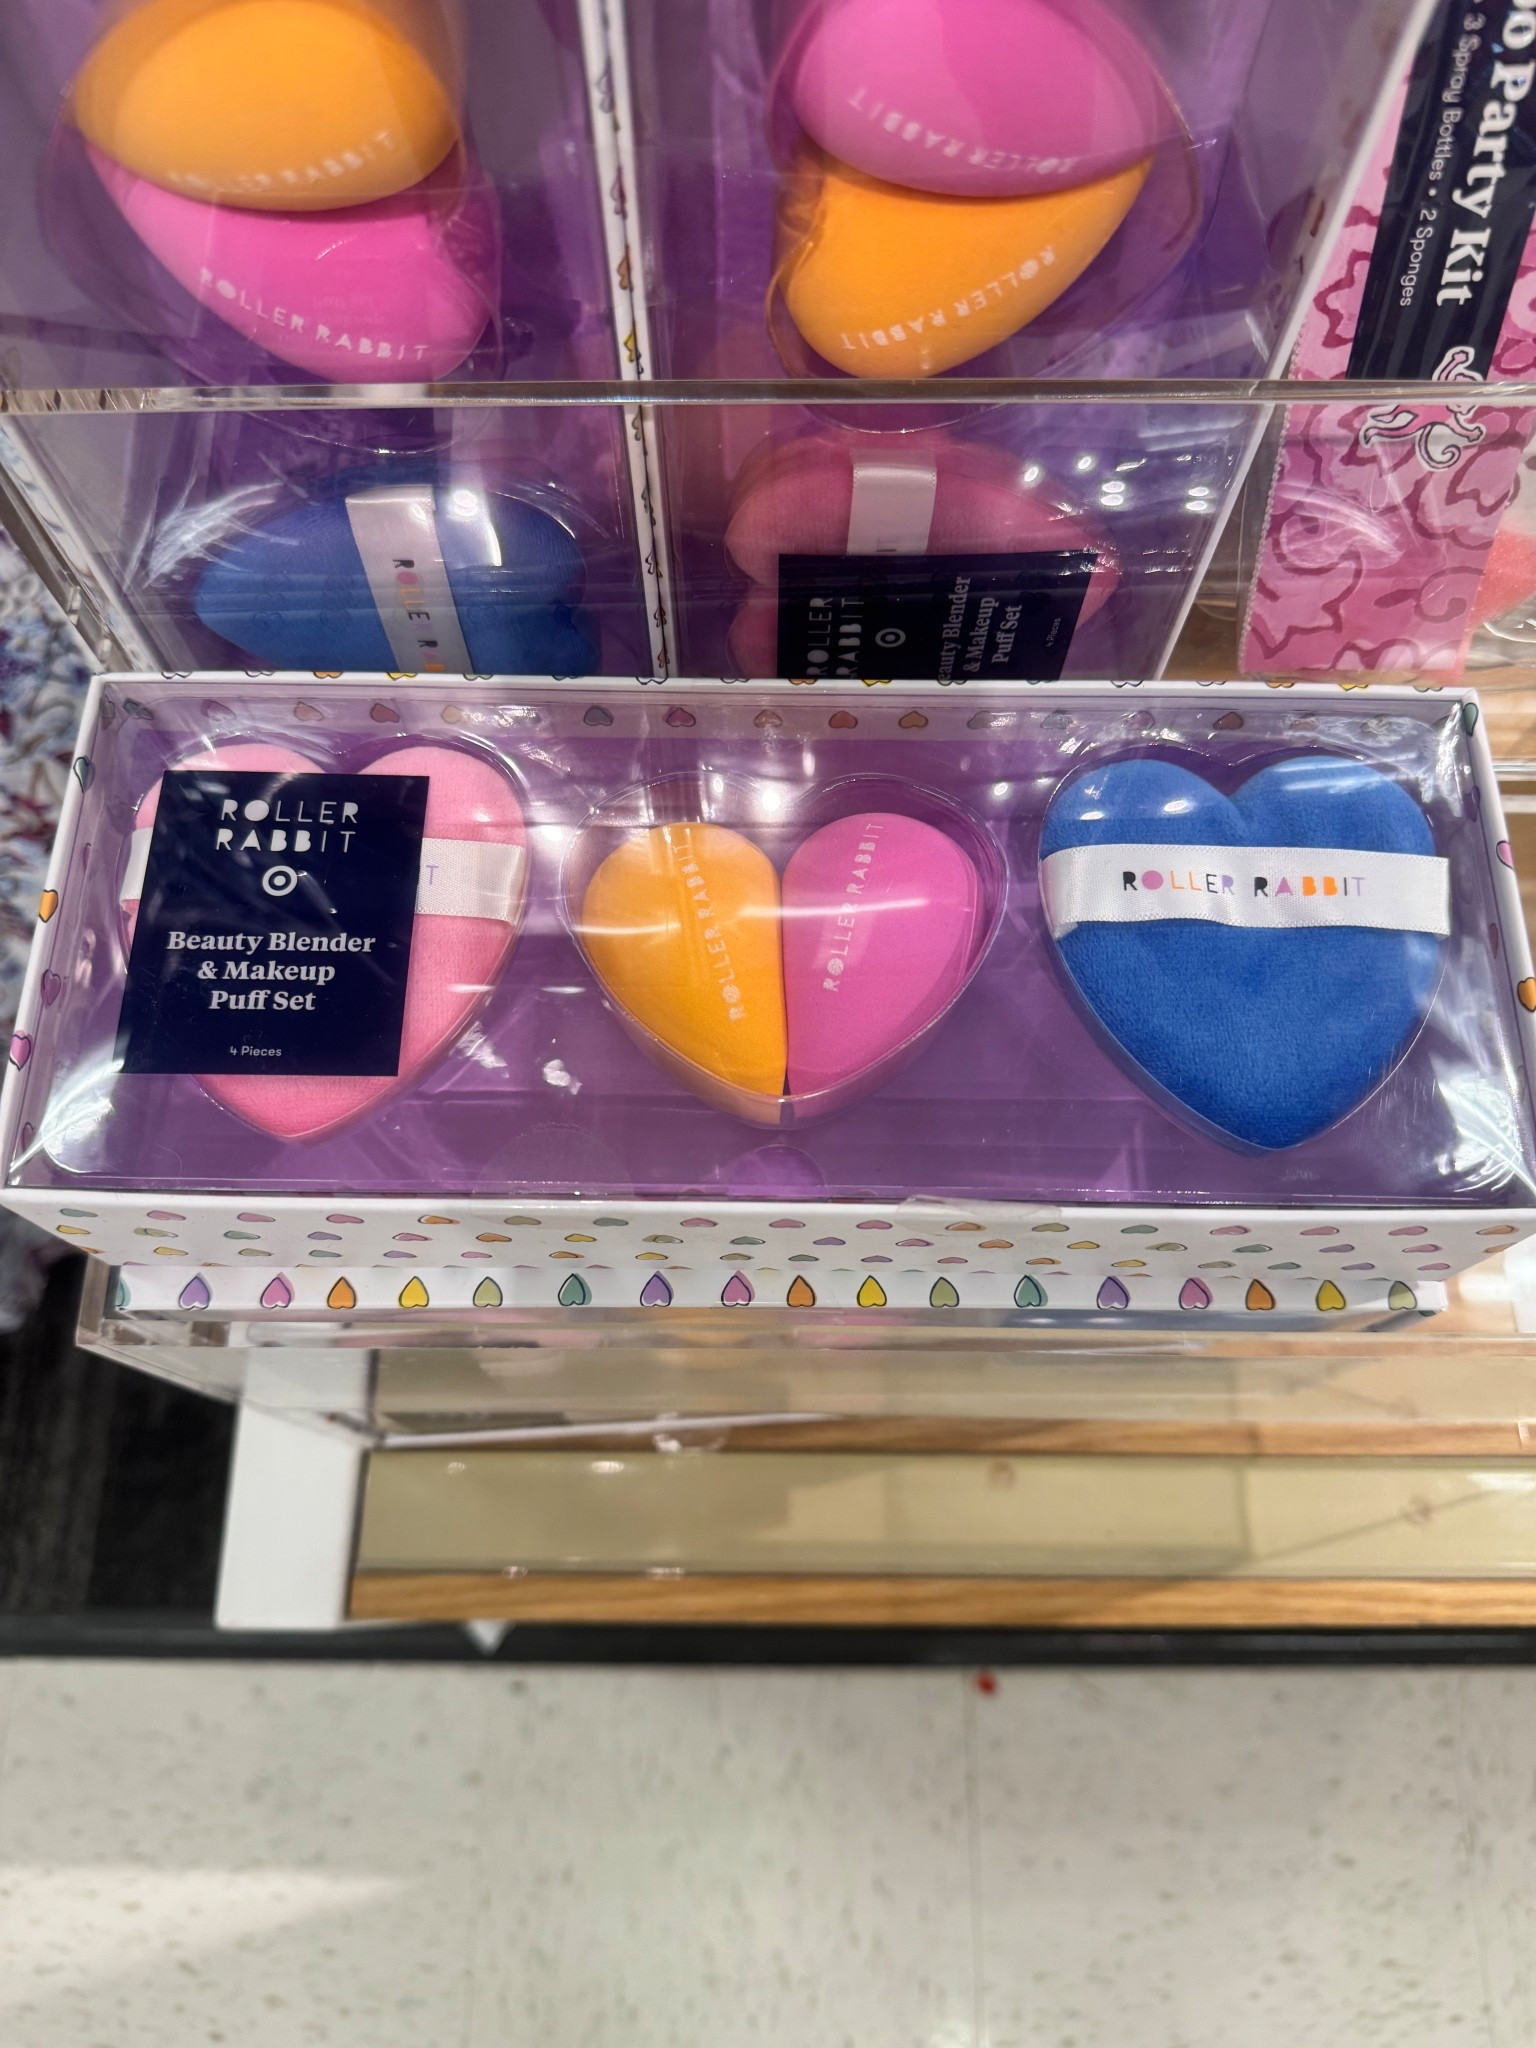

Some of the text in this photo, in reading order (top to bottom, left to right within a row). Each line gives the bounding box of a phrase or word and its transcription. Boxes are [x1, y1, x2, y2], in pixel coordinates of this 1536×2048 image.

[847, 86, 965, 158] RABBIT
[1400, 12, 1486, 307] 3 Spray Bottles 2 Sponges
[1452, 59, 1536, 218] Party
[840, 245, 1057, 350] ROLLER RABBIT
[1436, 228, 1490, 306] Kit
[199, 267, 429, 361] ROLLER RABBIT
[806, 597, 833, 676] ROLLER
[835, 597, 865, 679] RABBIT
[937, 576, 971, 682] eauty Blender
[962, 597, 1000, 673] & Makeup
[991, 604, 1022, 663] Puff Set
[215, 828, 357, 852] RABBIT
[220, 799, 359, 824] ROLLER
[823, 823, 884, 992] ROLLER RABBIT
[1122, 870, 1366, 898] ROLLER RABBIT
[166, 931, 376, 954] Beauty Blender
[673, 843, 746, 1021] ROLLER RABBIT
[197, 960, 336, 986] & Makeup
[208, 989, 316, 1011] Puff Set
[229, 1045, 282, 1057] 4 Pieces
